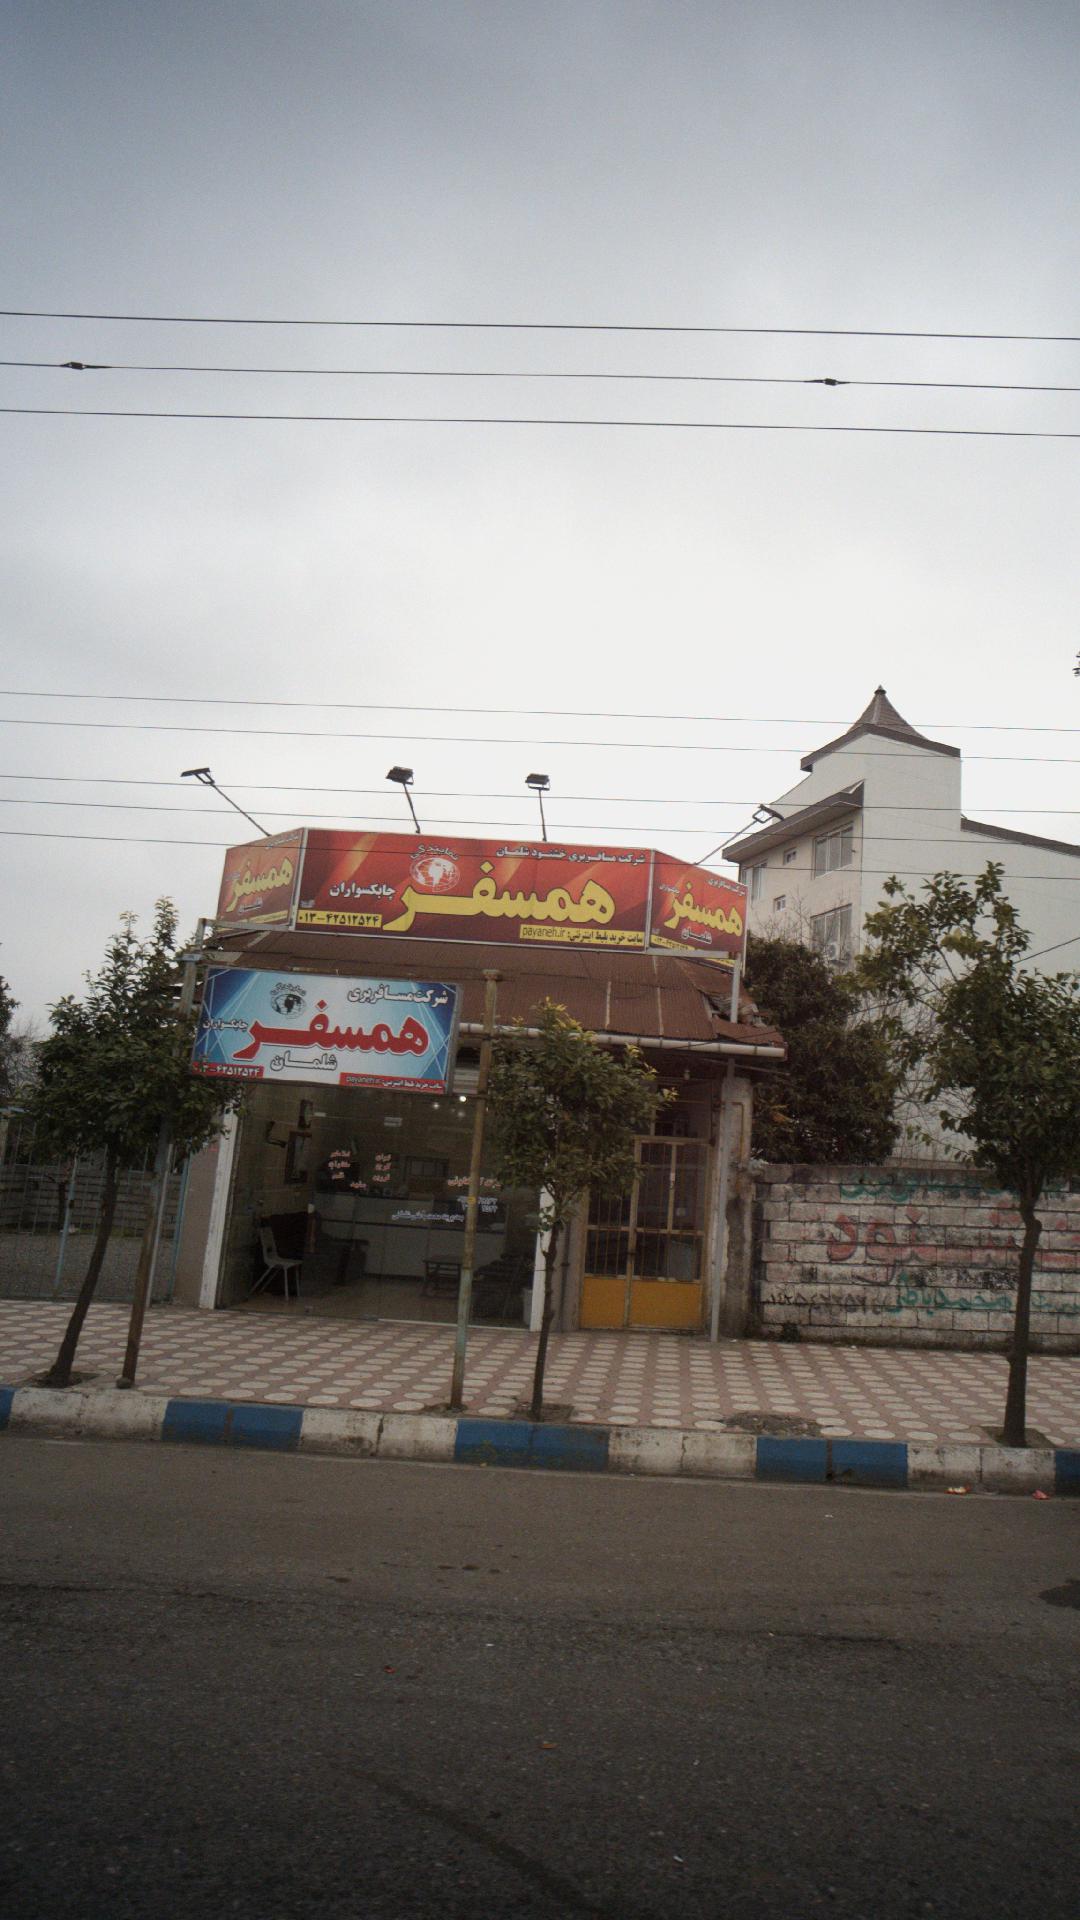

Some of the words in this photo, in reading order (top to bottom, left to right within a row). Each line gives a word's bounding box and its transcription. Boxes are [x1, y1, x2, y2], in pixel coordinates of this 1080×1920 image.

[568, 851, 617, 863] مسافربری
[618, 853, 646, 865] شرکت
[226, 857, 293, 913] همسفر
[329, 882, 396, 900] چابکسواران
[382, 861, 616, 932] همسفر
[664, 881, 743, 937] همسفر
[522, 926, 566, 938] payaneh.ir
[348, 984, 414, 1003] مسافربری
[414, 989, 449, 1007] شرکت
[232, 999, 430, 1061] همسفر
[270, 1050, 338, 1072] شلمان
